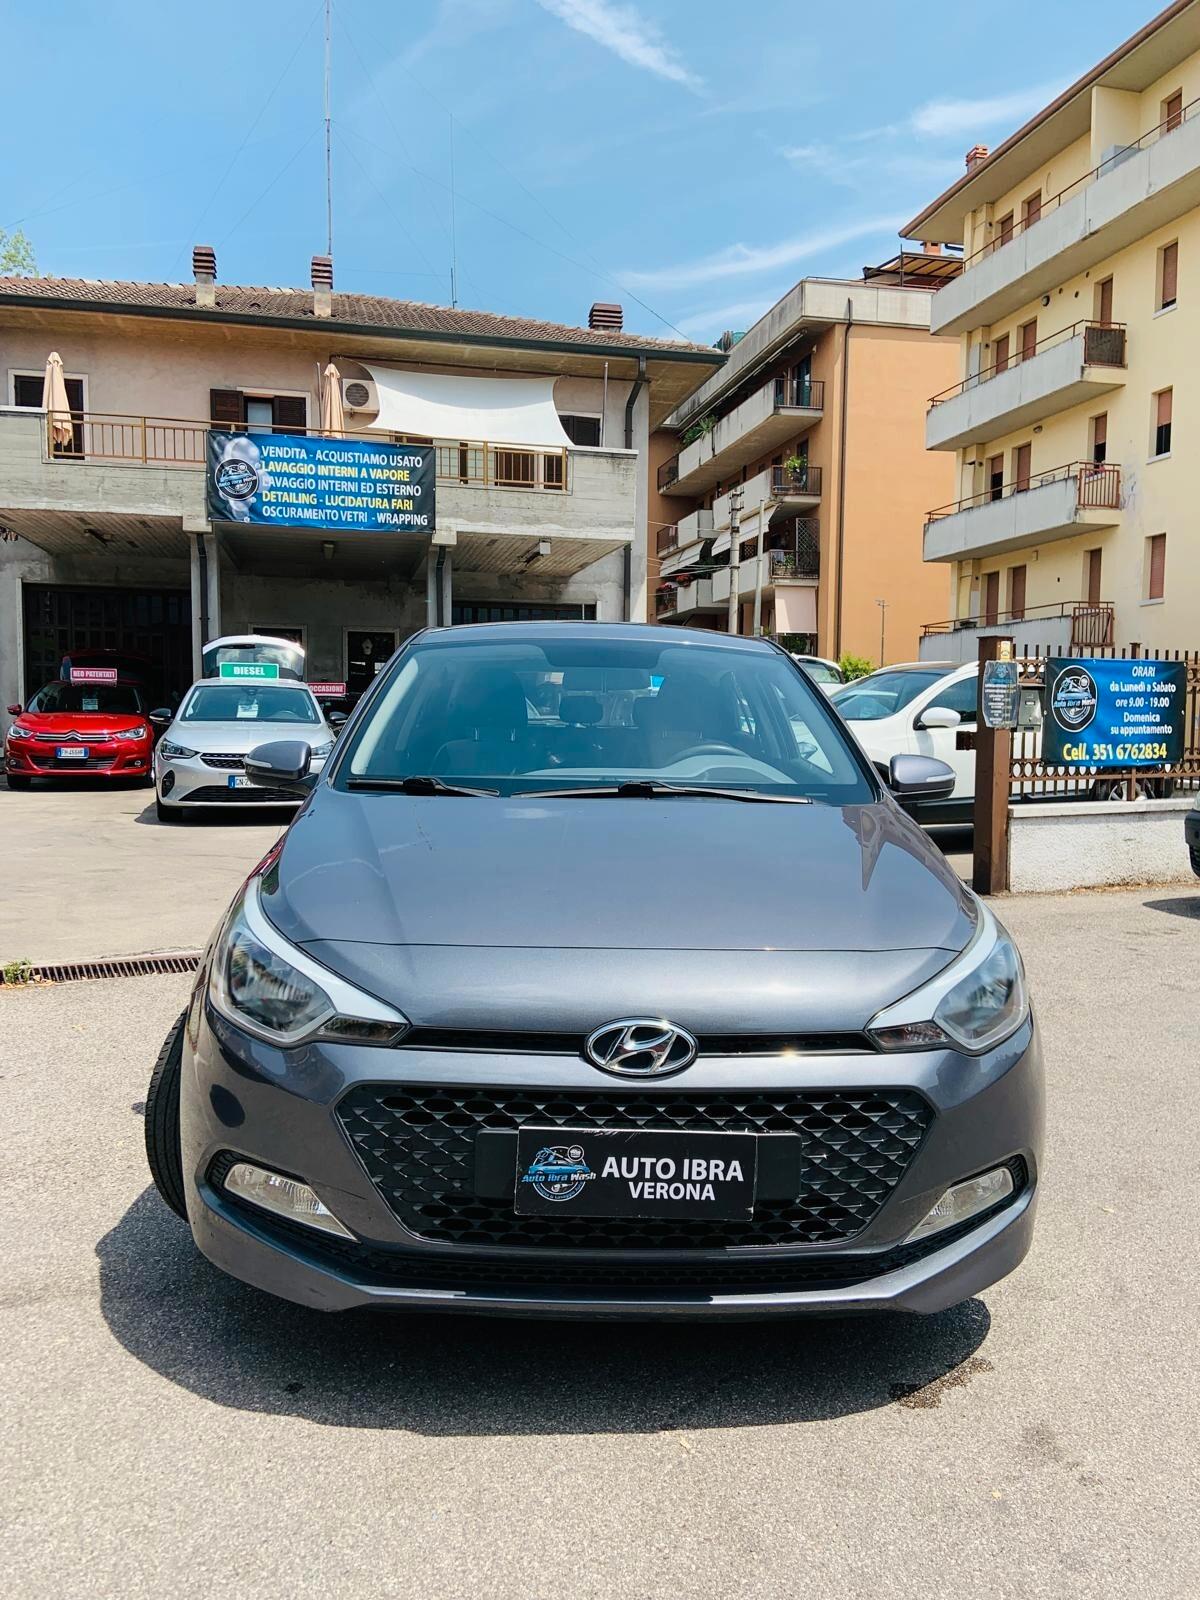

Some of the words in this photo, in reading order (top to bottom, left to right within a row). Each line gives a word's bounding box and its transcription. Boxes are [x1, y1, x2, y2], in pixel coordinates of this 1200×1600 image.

[261, 446, 307, 460] VENDITA
[315, 449, 387, 466] ACQUISTIAMO
[389, 455, 423, 468] USATO
[261, 460, 316, 476] LAVAGGIO
[317, 464, 359, 478] INTERNI
[360, 467, 368, 479] A
[369, 468, 410, 481] VAPORE
[262, 475, 316, 490] LAVAGGIO
[317, 479, 359, 493] INTERNI
[360, 482, 375, 494] ED
[376, 483, 422, 497] ESTERNO
[262, 490, 318, 505] DETAILING
[325, 494, 390, 509] LUCIDATURA
[391, 498, 413, 511] FARI
[262, 505, 339, 521] OSCURAMENTO
[340, 510, 368, 523] VETRI
[376, 512, 428, 526] WRAPPING
[233, 666, 266, 676] DIESEL
[1131, 665, 1156, 678] ORARI
[310, 684, 344, 693] OCCASIONE
[1109, 681, 1119, 692] da
[1146, 684, 1151, 692] a
[1152, 681, 1177, 693] Sabato
[1115, 698, 1128, 708] ore
[1128, 696, 1145, 708] 9.00
[1150, 696, 1170, 708] 19.00
[1123, 711, 1161, 723] Domenica
[1110, 725, 1119, 735] su
[1119, 724, 1173, 737] appuntamento
[1062, 743, 1090, 761] Cell.
[1092, 743, 1113, 760] 351
[1115, 742, 1168, 760] 6762834
[601, 1156, 676, 1180] AUTO
[682, 1159, 744, 1182] IBRA
[521, 1174, 545, 1183] Auto
[570, 1172, 597, 1181] Wash
[628, 1181, 716, 1201] VERONA
